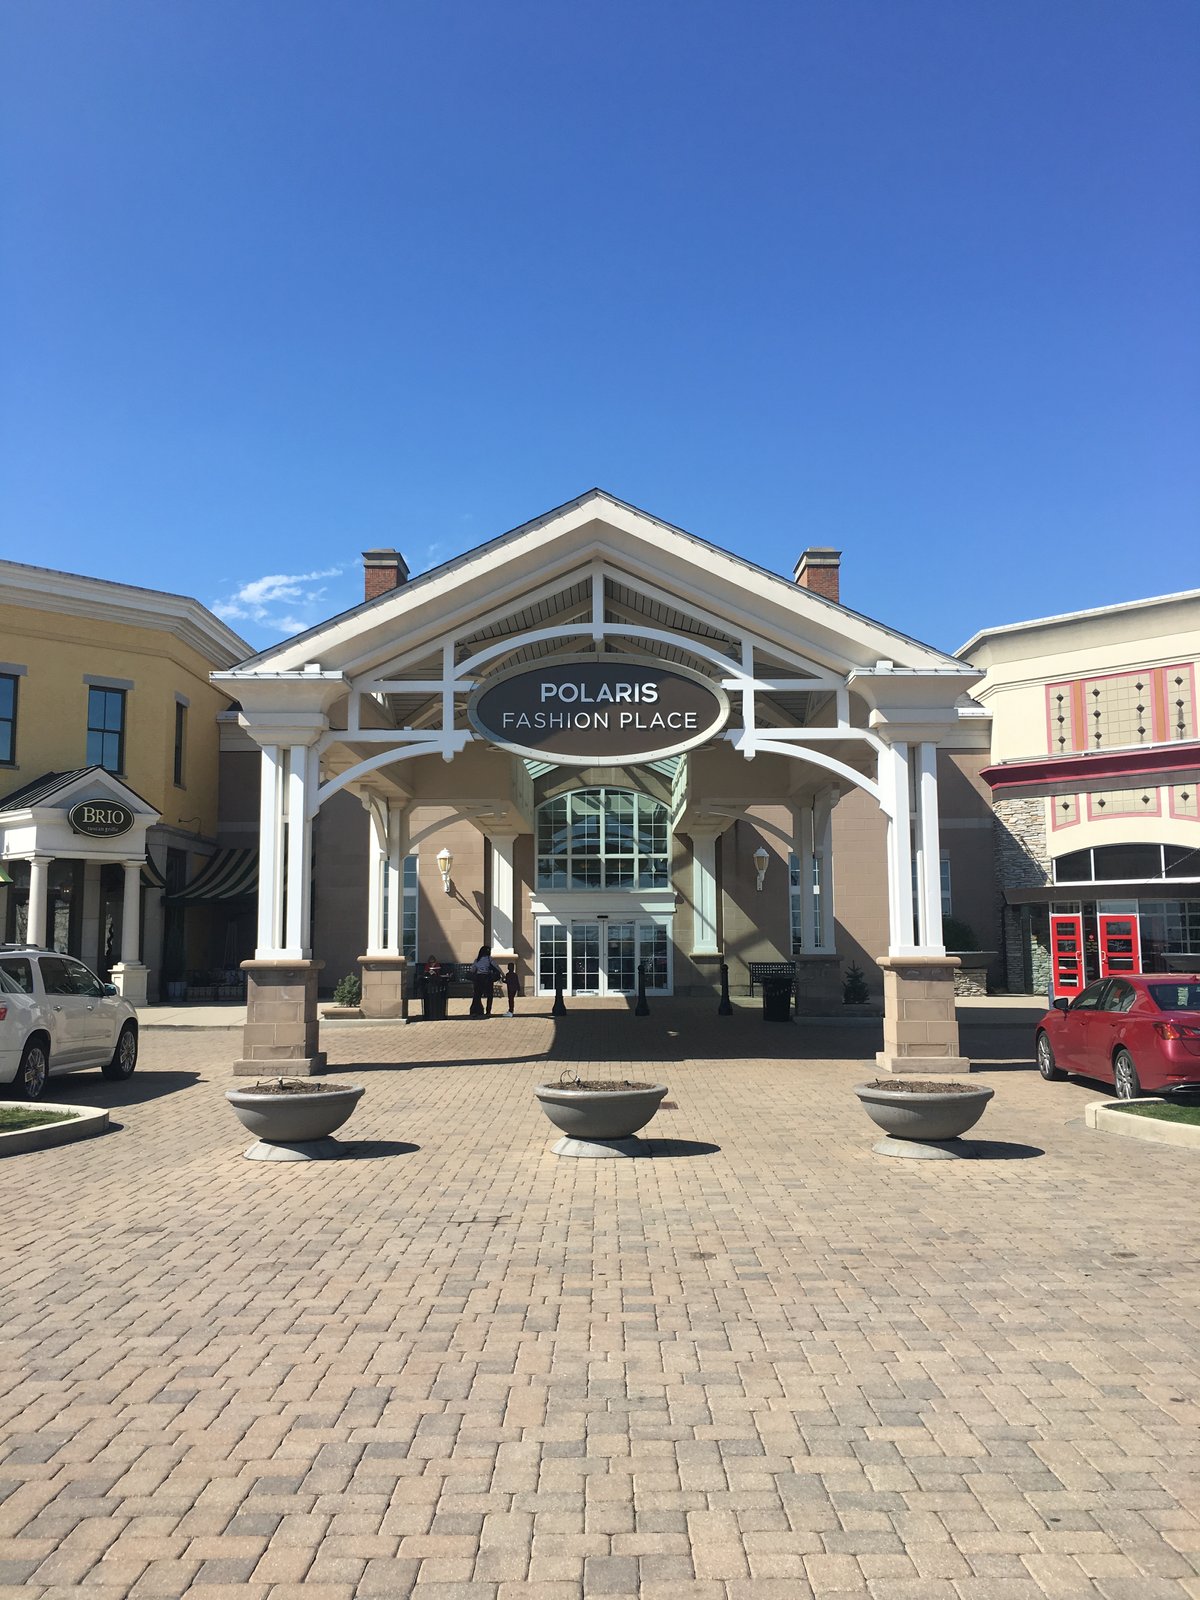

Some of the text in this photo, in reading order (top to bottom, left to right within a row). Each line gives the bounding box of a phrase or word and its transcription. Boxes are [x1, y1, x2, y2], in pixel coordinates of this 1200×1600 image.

[540, 682, 659, 703] POLARIS
[502, 712, 697, 729] FASHION PLACE
[82, 806, 124, 824] BRIO
